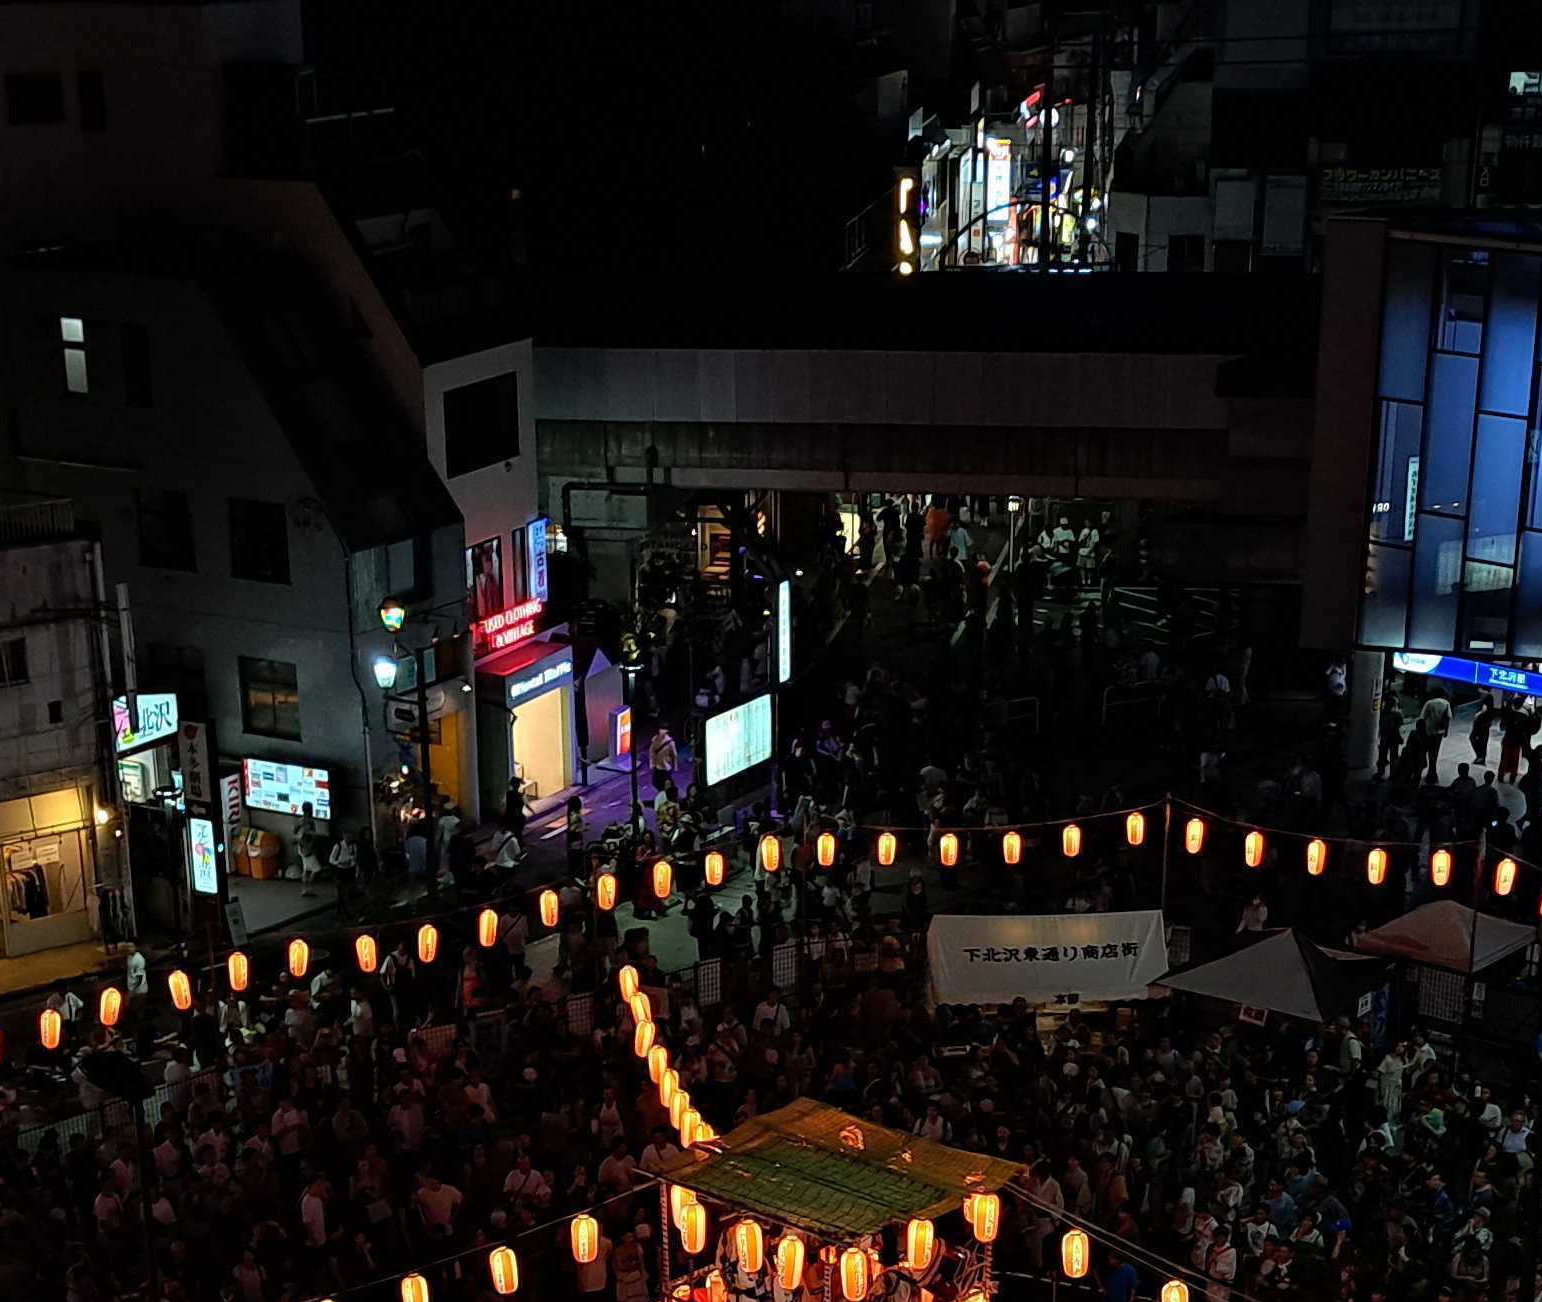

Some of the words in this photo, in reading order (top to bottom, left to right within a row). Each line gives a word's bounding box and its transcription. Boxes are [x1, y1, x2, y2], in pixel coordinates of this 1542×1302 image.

[484, 612, 505, 635] USED
[505, 597, 542, 627] CLOTHING
[962, 941, 1140, 964] 下北沢東通り商店街
